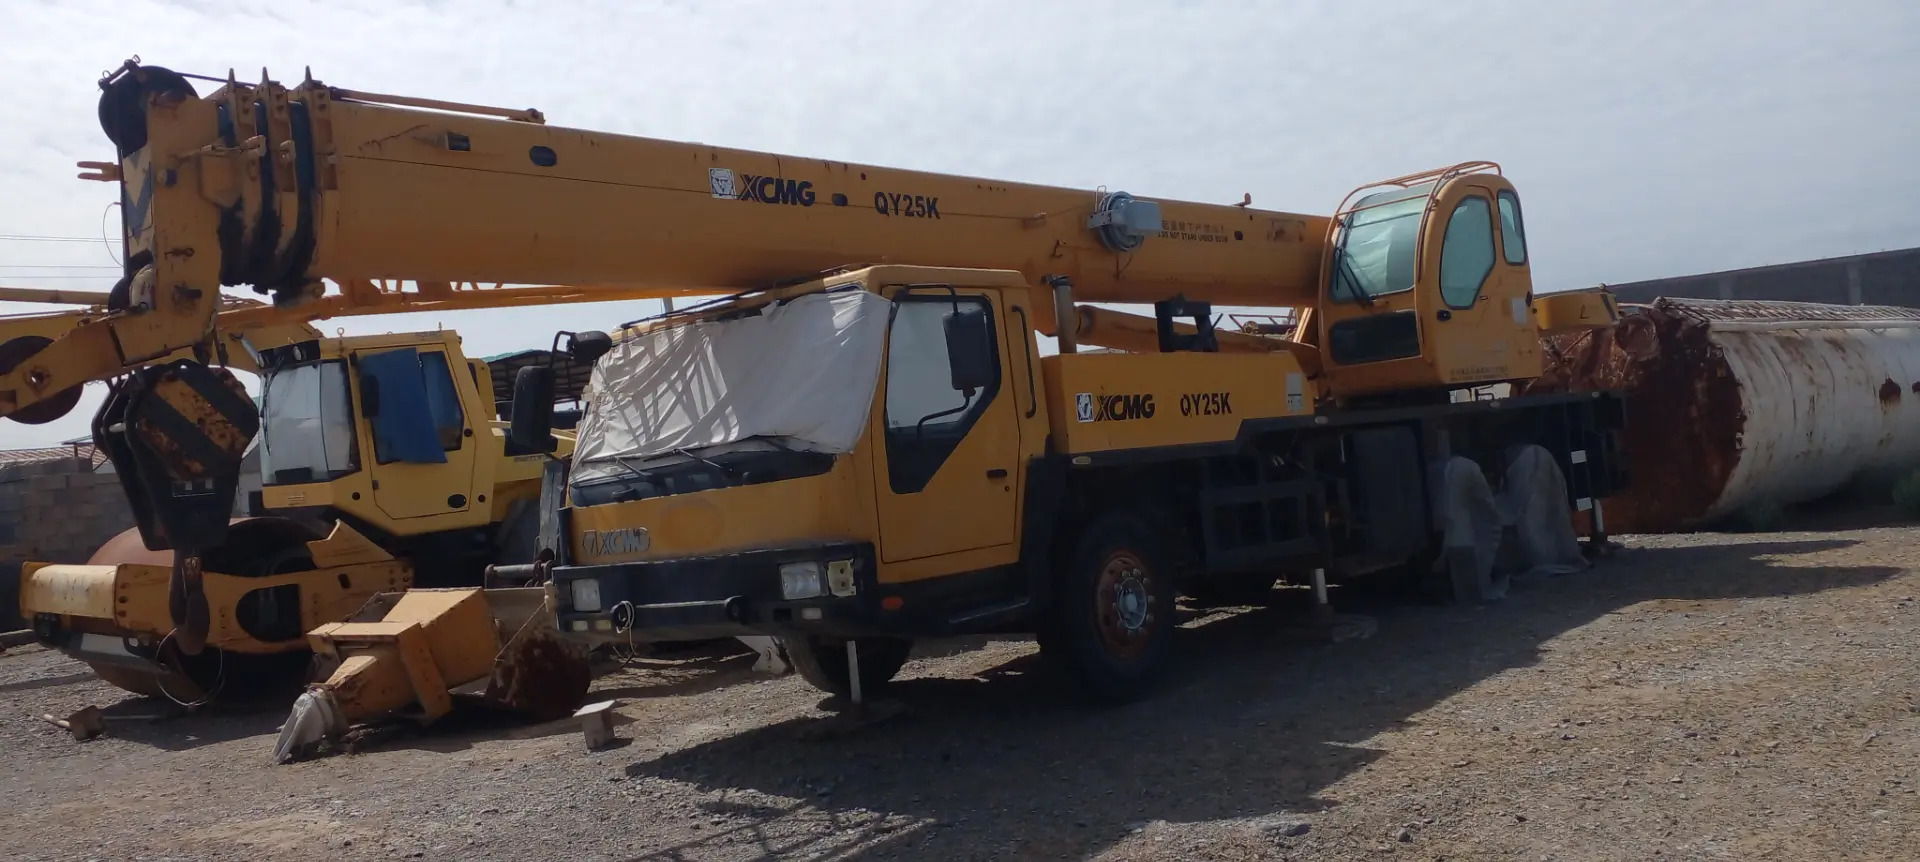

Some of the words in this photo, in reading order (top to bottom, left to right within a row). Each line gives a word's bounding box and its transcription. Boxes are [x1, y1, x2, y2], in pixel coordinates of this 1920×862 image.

[739, 174, 815, 206] XCMG
[874, 191, 940, 219] QY25K
[1095, 394, 1155, 421] XCMG
[1180, 392, 1232, 417] QY25K
